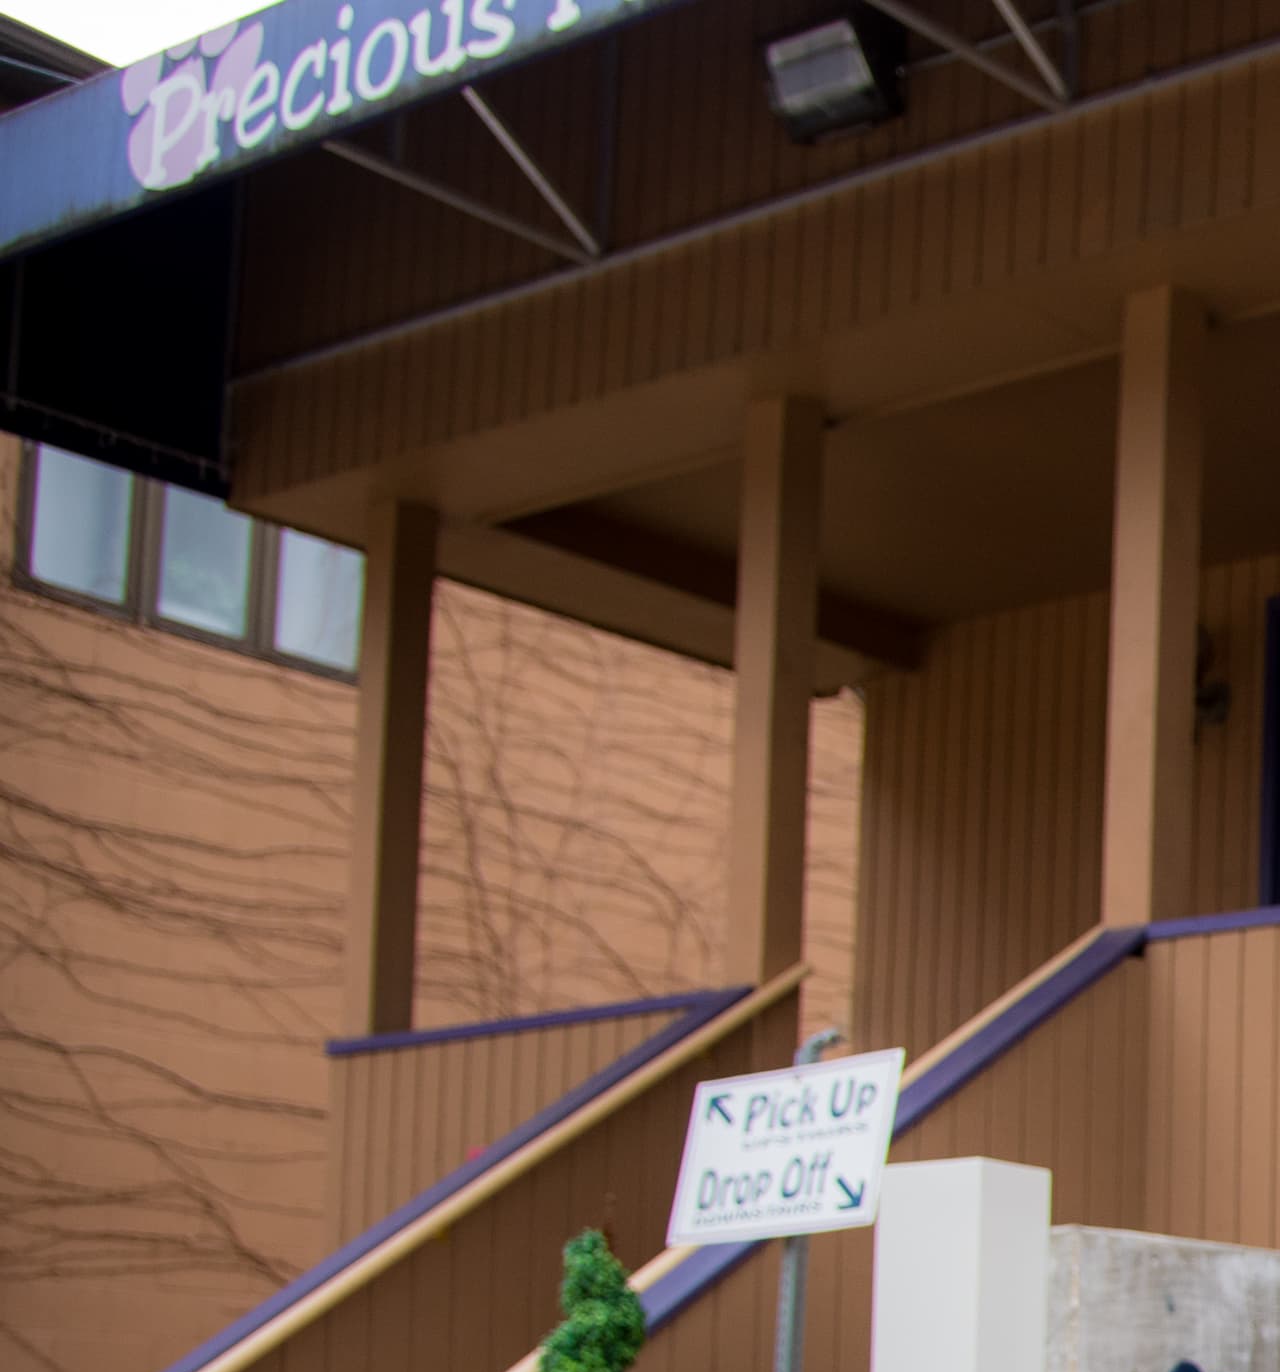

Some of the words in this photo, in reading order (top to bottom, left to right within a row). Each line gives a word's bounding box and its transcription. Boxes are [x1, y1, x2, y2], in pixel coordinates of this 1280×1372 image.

[145, 0, 515, 189] Precious
[743, 1086, 816, 1133] Pick
[697, 1169, 772, 1210] Drop
[781, 1152, 833, 1198] Off
